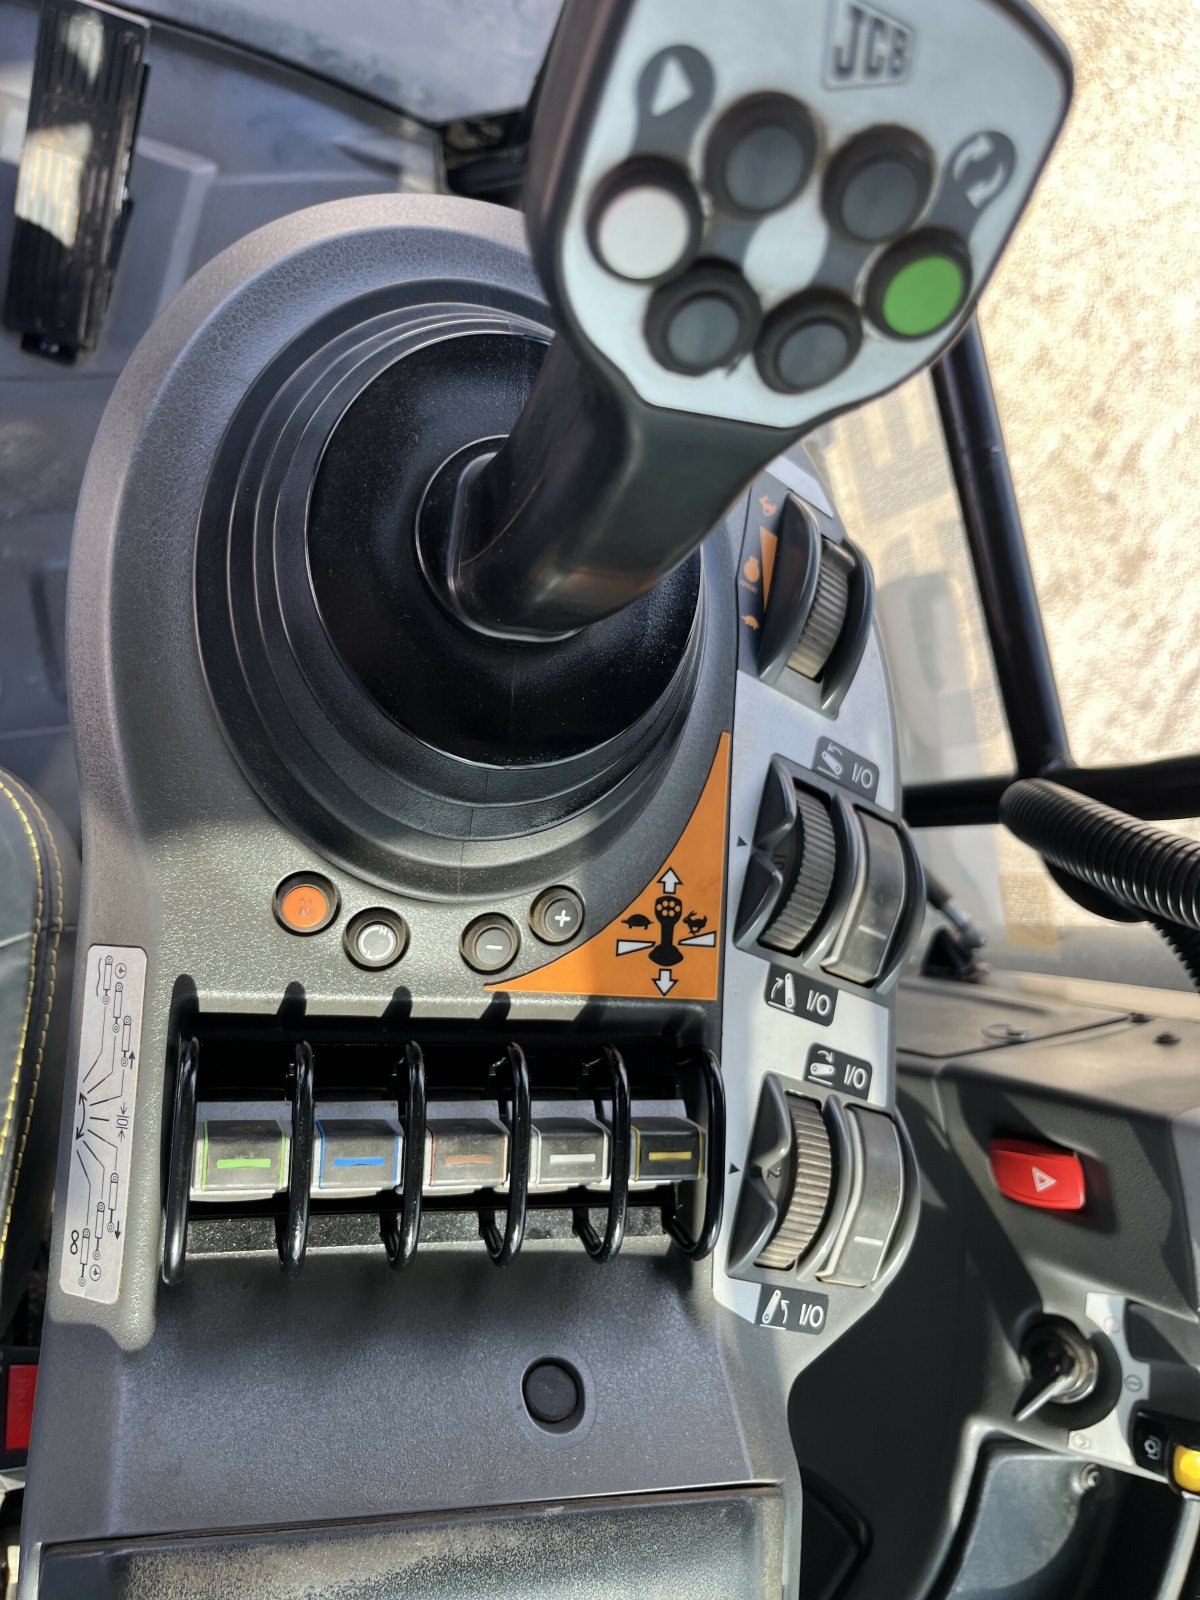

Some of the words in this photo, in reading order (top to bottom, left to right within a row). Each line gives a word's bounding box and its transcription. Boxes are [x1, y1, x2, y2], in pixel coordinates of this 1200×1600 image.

[832, 5, 909, 80] JCB
[852, 762, 872, 789] I/O
[298, 897, 313, 918] N
[806, 989, 832, 1016] I/O
[843, 1063, 867, 1089] I/O
[798, 1303, 824, 1328] I/O
